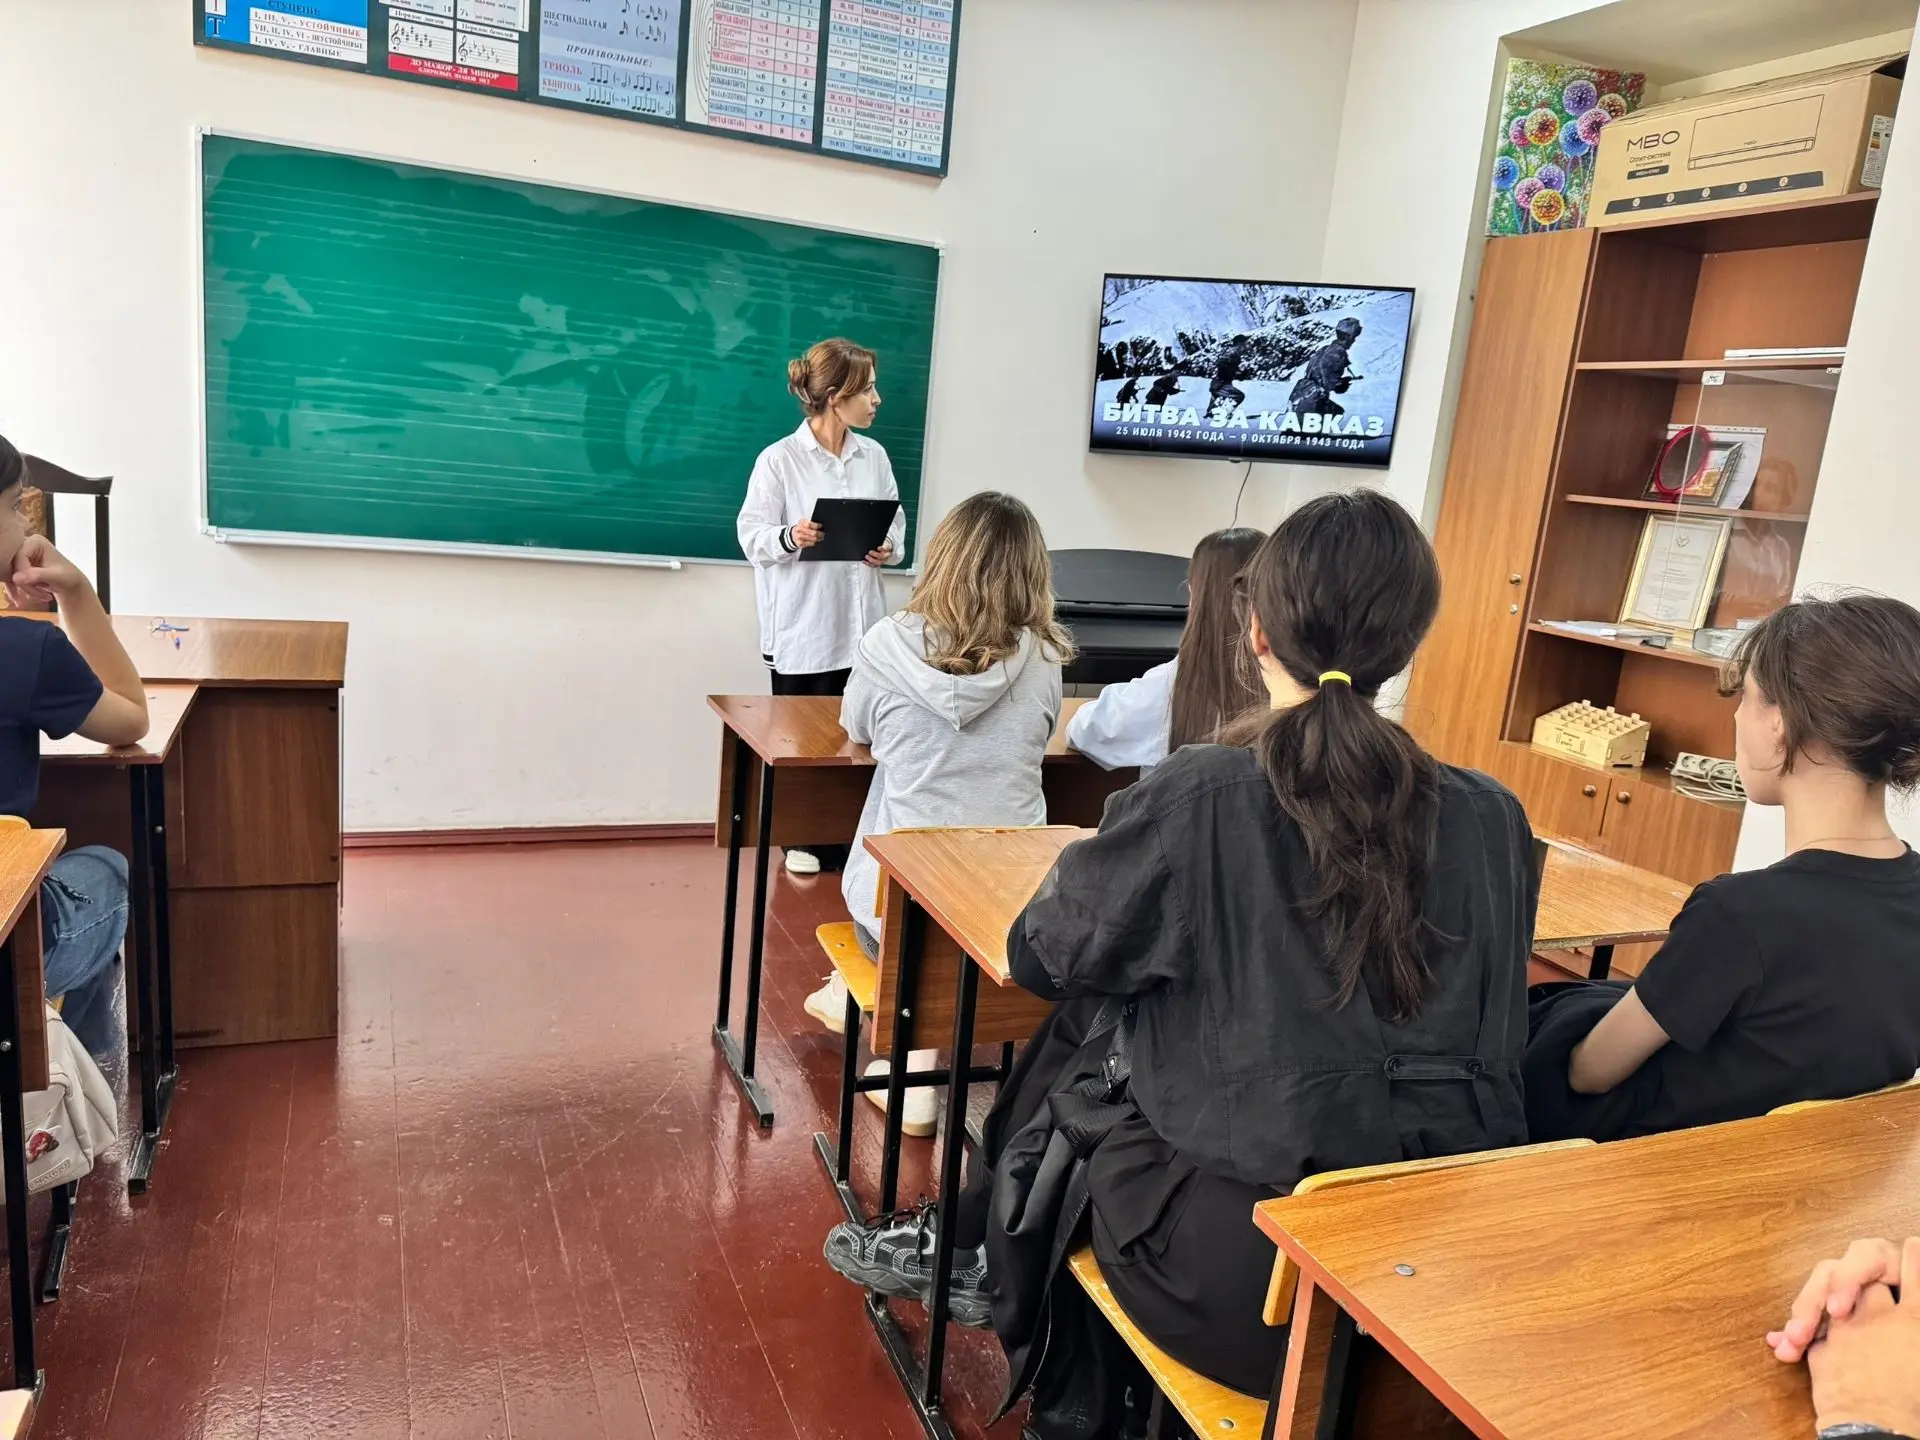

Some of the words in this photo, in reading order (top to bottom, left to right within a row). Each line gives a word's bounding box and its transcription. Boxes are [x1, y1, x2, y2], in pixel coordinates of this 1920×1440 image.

[299, 20, 361, 37] УСТОЙЧИВЫЕ
[298, 43, 342, 57] ГЛАВНЫЕ
[312, 34, 363, 49] НЕУСТОЙЧИВЫЕ
[1626, 130, 1680, 152] MBO
[1103, 402, 1200, 426] БИТВА
[1209, 406, 1249, 429] ЗА
[1258, 411, 1385, 437] КАВКАЗ
[1116, 426, 1128, 435] 25
[1132, 427, 1162, 437] ИЮЛЯ
[1168, 429, 1192, 439] 1942
[1196, 431, 1225, 442] ГОДА
[1241, 433, 1247, 442] 9
[1251, 434, 1301, 445] ОКТЯБРЯ
[1306, 437, 1331, 446] 1943
[1336, 438, 1365, 449] ГОДА
